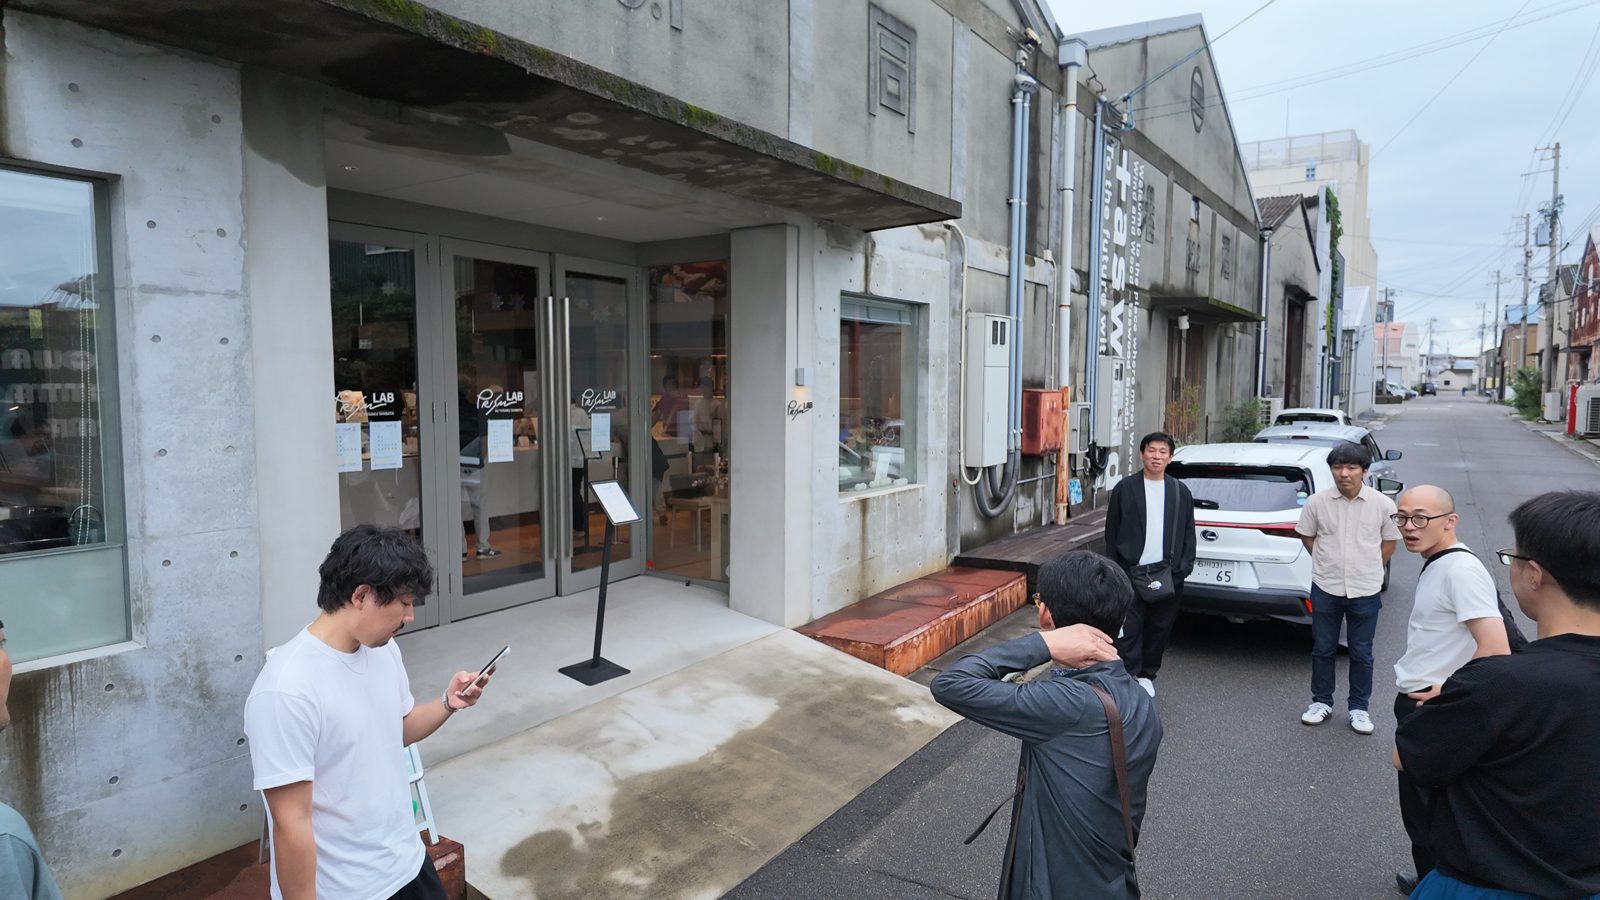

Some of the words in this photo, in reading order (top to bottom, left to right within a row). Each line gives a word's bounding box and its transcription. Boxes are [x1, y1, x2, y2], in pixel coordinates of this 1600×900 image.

[1105, 145, 1114, 171] To
[1103, 180, 1112, 220] the
[1136, 165, 1144, 237] Welcome
[1136, 243, 1141, 257] to
[1100, 229, 1110, 307] future
[372, 392, 395, 403] LAB
[506, 391, 523, 401] LAB
[603, 390, 616, 399] LAB
[1216, 570, 1231, 582] 65
